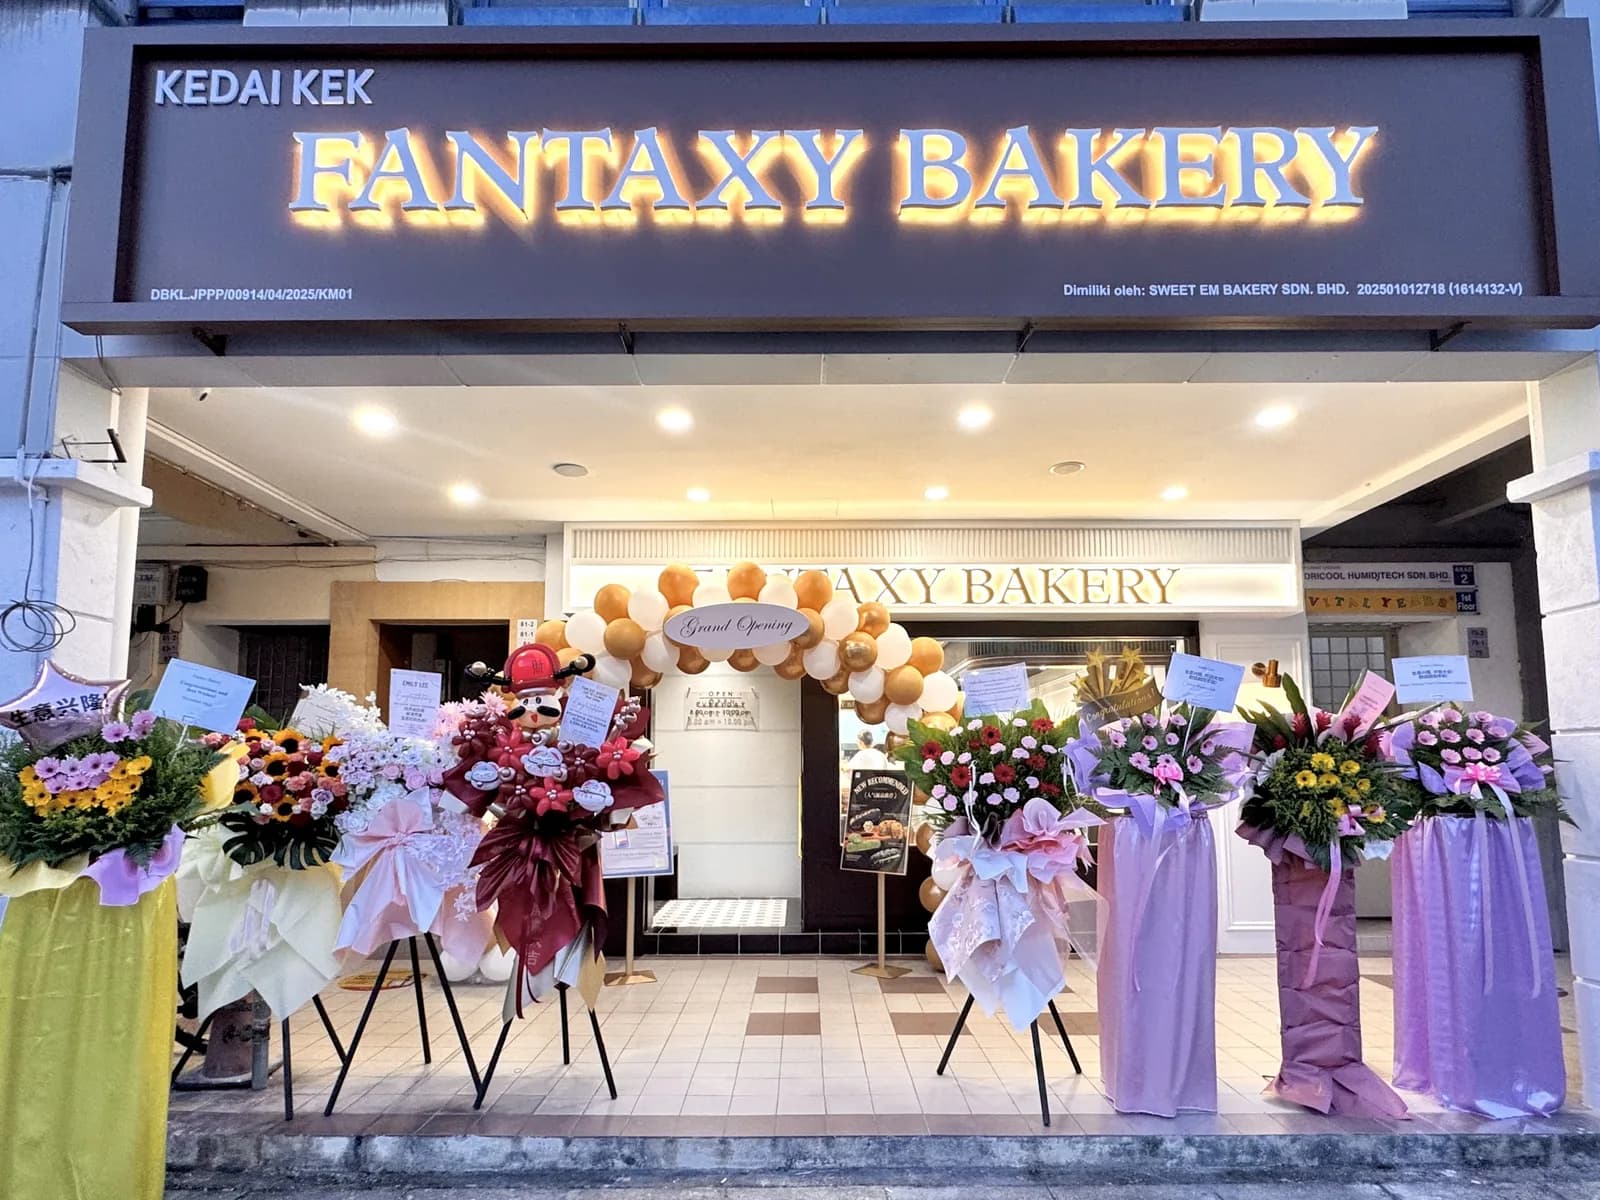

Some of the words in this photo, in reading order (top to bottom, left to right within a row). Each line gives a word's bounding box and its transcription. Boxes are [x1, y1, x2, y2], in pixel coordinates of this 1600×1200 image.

[154, 69, 281, 105] KEDAI
[292, 68, 375, 105] KEK
[288, 127, 864, 219] FANTAXY
[898, 125, 1379, 211] BAKERY
[1063, 284, 1111, 297] Dimiliki
[1114, 284, 1146, 297] oleh:
[1149, 284, 1196, 296] SWEET
[1199, 284, 1220, 296] EM
[1223, 283, 1279, 296] BAKERY
[1281, 283, 1314, 296] SDN.
[1316, 283, 1350, 296] BHD.
[1357, 283, 1446, 296] 202501012718
[1449, 282, 1523, 297] (1614132-V)
[961, 567, 1181, 605] BAKERY
[1460, 574, 1470, 584] 2
[1457, 602, 1476, 611] Floor
[1460, 594, 1472, 602] 1st
[679, 615, 732, 638] Grand
[736, 614, 795, 637] Opening
